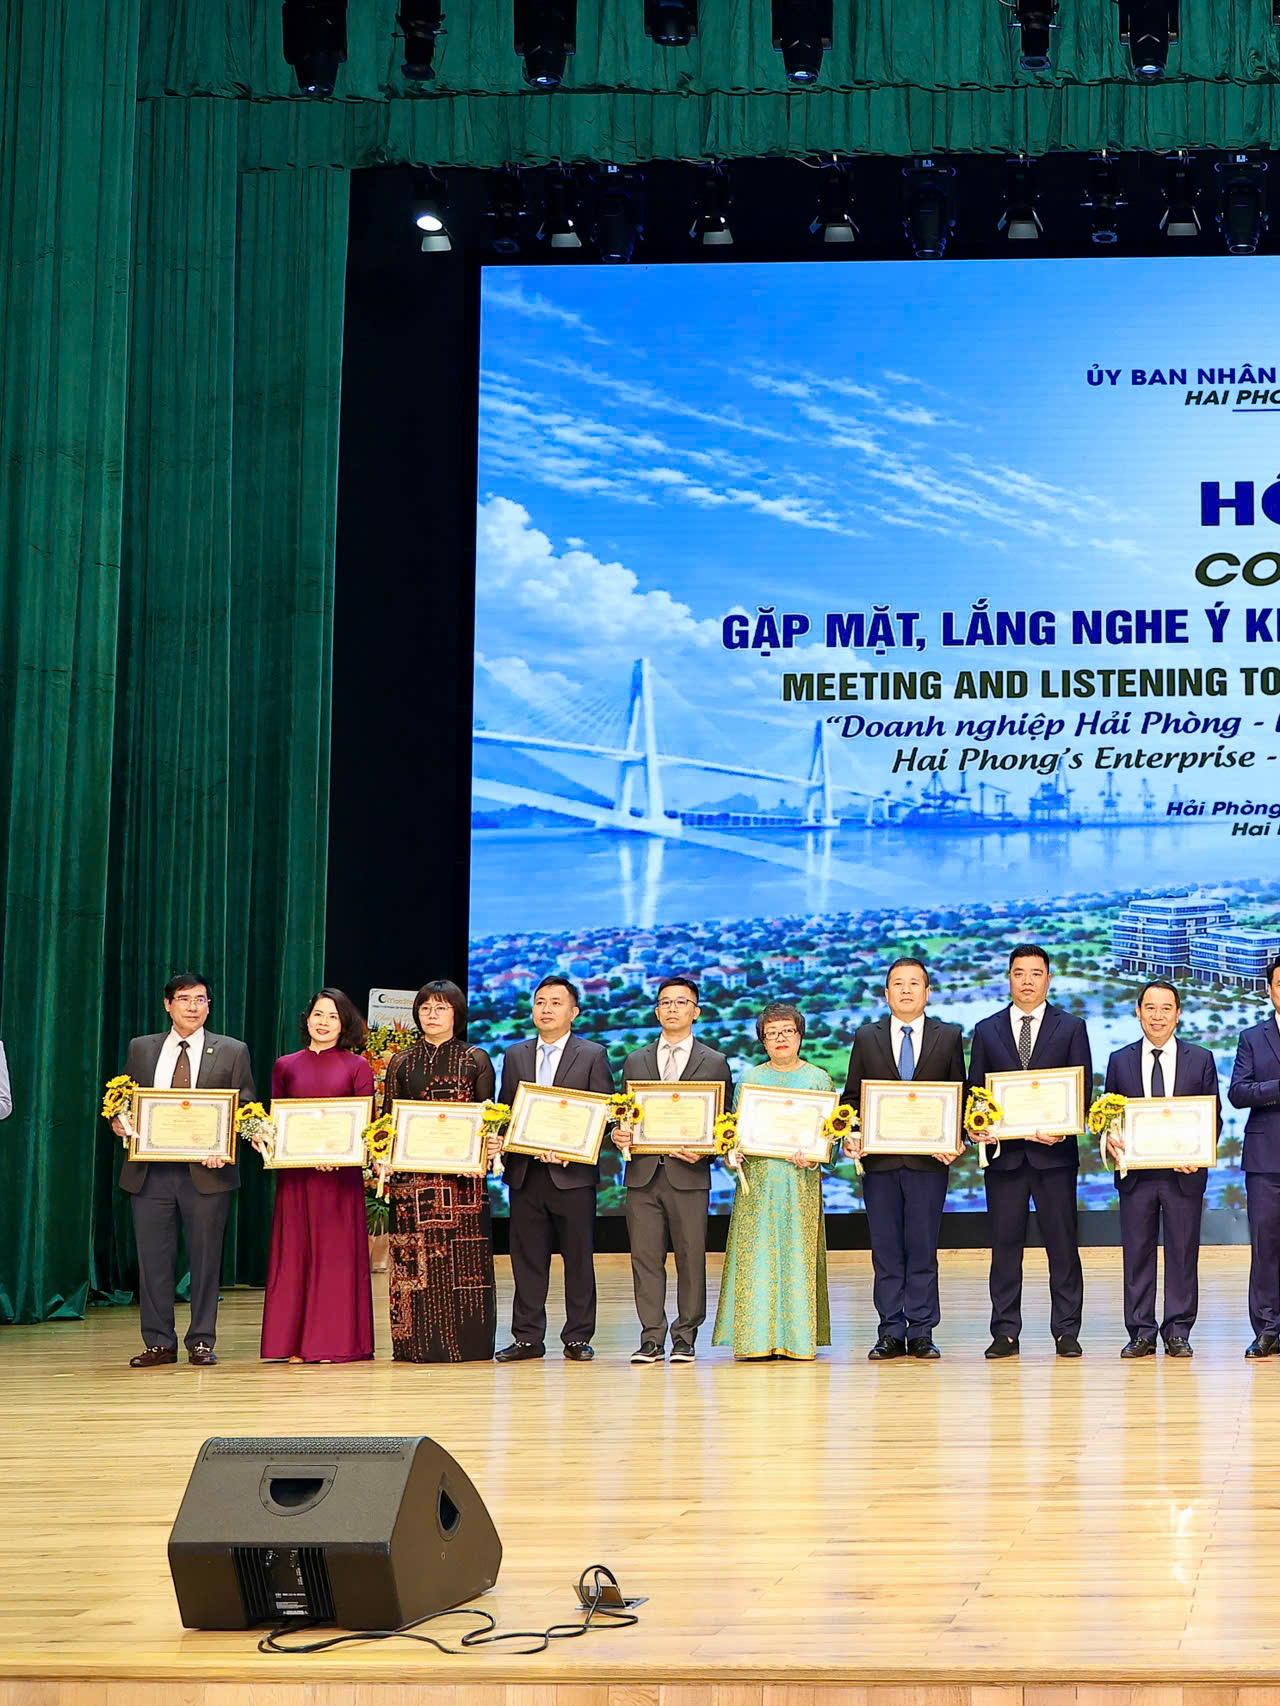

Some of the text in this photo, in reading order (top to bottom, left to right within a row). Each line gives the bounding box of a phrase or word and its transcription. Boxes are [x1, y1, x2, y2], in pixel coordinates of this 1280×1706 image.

[1086, 363, 1122, 387] ỦY
[1131, 368, 1187, 386] BAN
[1197, 363, 1277, 385] NHÂN
[1184, 390, 1230, 406] HAI
[722, 606, 810, 657] GẶP
[826, 605, 926, 656] MẶT,
[942, 598, 1056, 647] LẮNG
[1072, 609, 1189, 645] NGHE
[1204, 601, 1231, 643] Ý
[783, 670, 942, 702] MEETING
[953, 670, 1028, 700] AND
[1041, 667, 1227, 699] LISTENING
[954, 712, 1065, 742] nghiệp
[1074, 710, 1132, 737] Hải
[1140, 710, 1242, 739] Phòng
[891, 746, 949, 774] Hai
[1094, 744, 1256, 774] Enterprise
[1166, 799, 1206, 817] Hải
[1231, 821, 1272, 837] Hai
